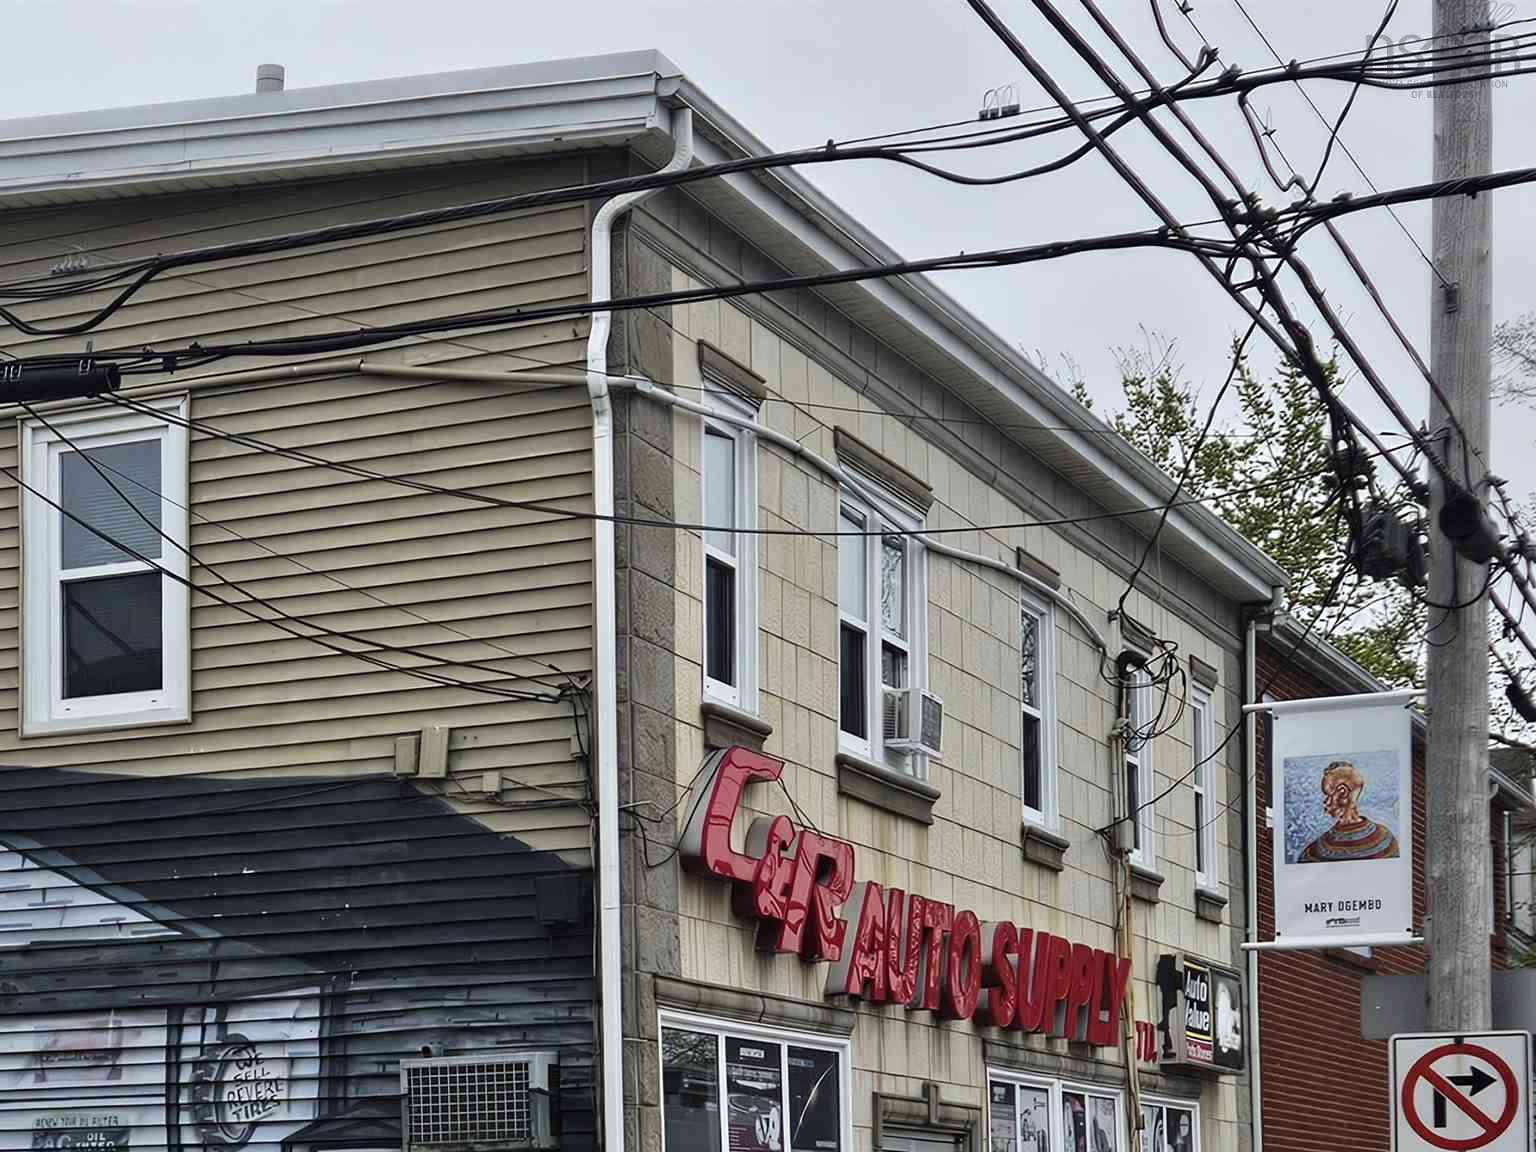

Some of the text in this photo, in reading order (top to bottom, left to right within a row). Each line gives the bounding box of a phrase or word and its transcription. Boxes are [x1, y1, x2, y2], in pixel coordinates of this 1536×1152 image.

[1305, 899, 1382, 913] MARY OGEMBO
[842, 880, 982, 1020] AUTO
[989, 920, 1132, 1047] SUPPLY
[232, 1094, 281, 1120] TIRES
